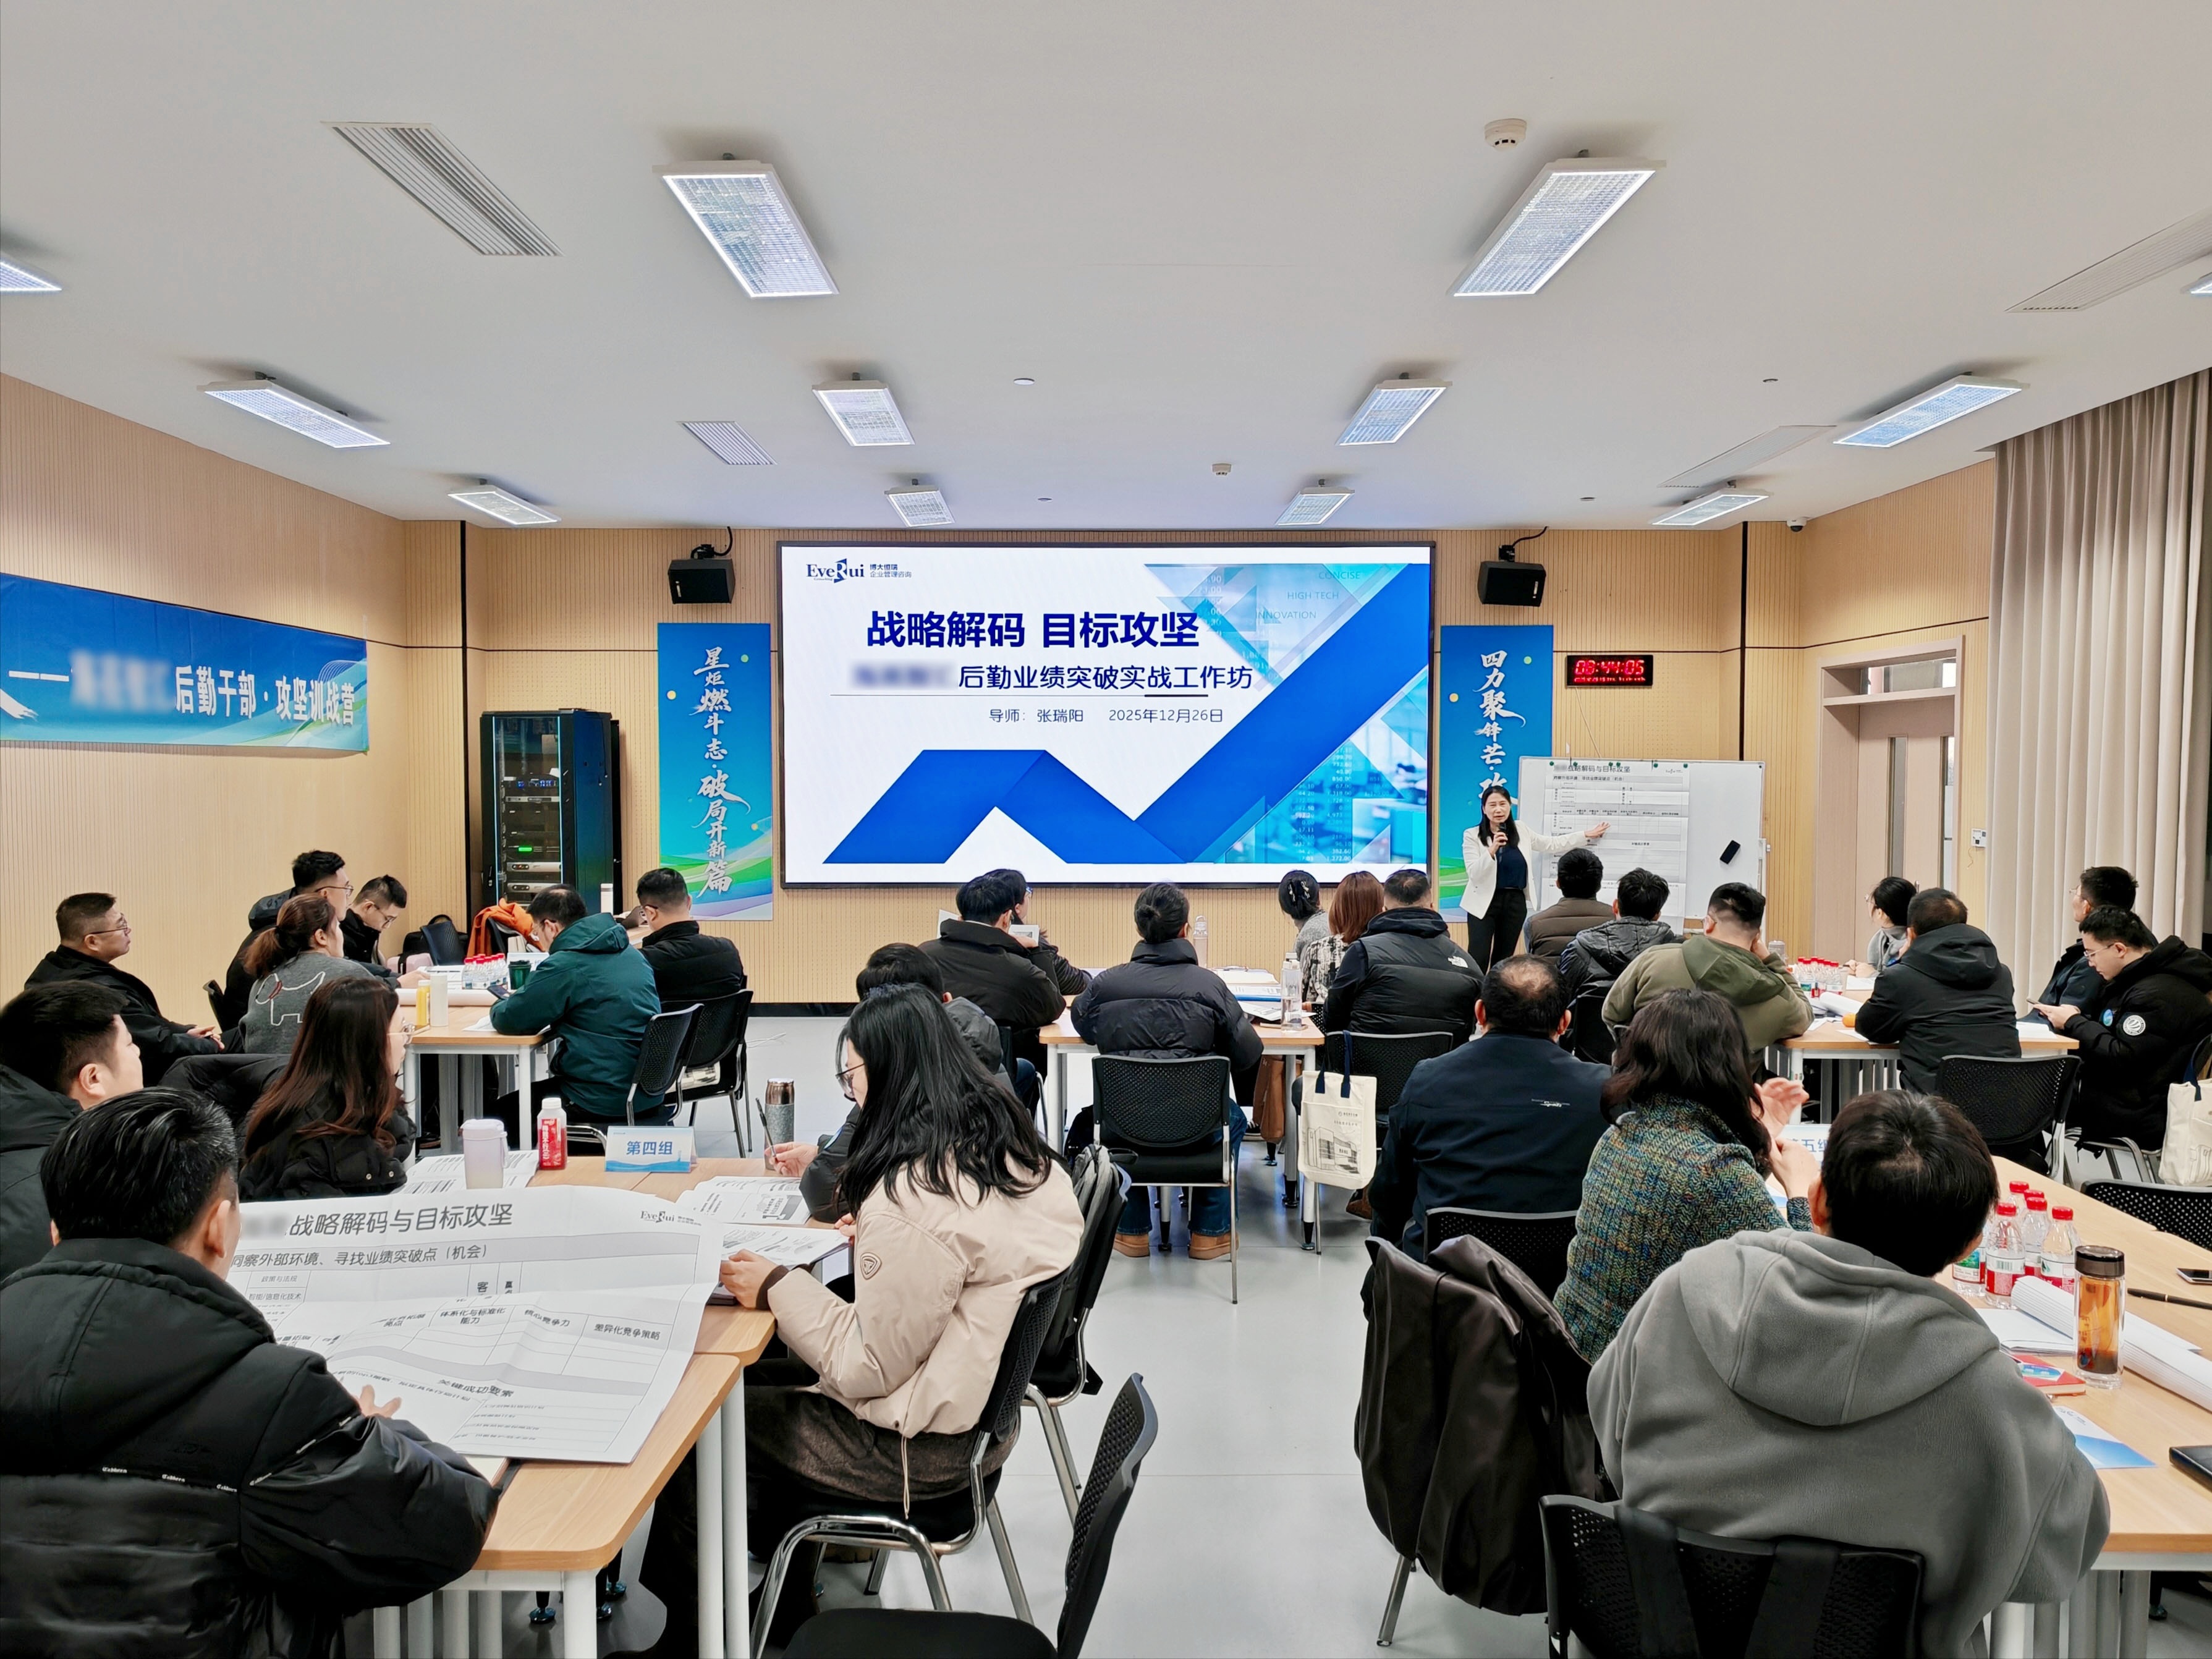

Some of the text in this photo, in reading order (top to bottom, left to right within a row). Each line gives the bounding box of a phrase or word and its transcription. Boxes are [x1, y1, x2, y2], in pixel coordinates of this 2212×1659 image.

[806, 558, 865, 583] EveRui
[1318, 571, 1360, 580] CONCISE
[1287, 592, 1339, 600] HIGH TECH
[1256, 611, 1316, 619] NNOVATION
[867, 611, 1200, 648] 战略解码 目标攻坚
[959, 664, 1253, 690] 后勤业绩突破实战工作坊
[1109, 708, 1224, 723] 2025年12月26日
[625, 1140, 673, 1155] 第四组
[289, 1203, 513, 1237] 战略解码与目标攻坚
[594, 1323, 661, 1341] 差异化竞争策略
